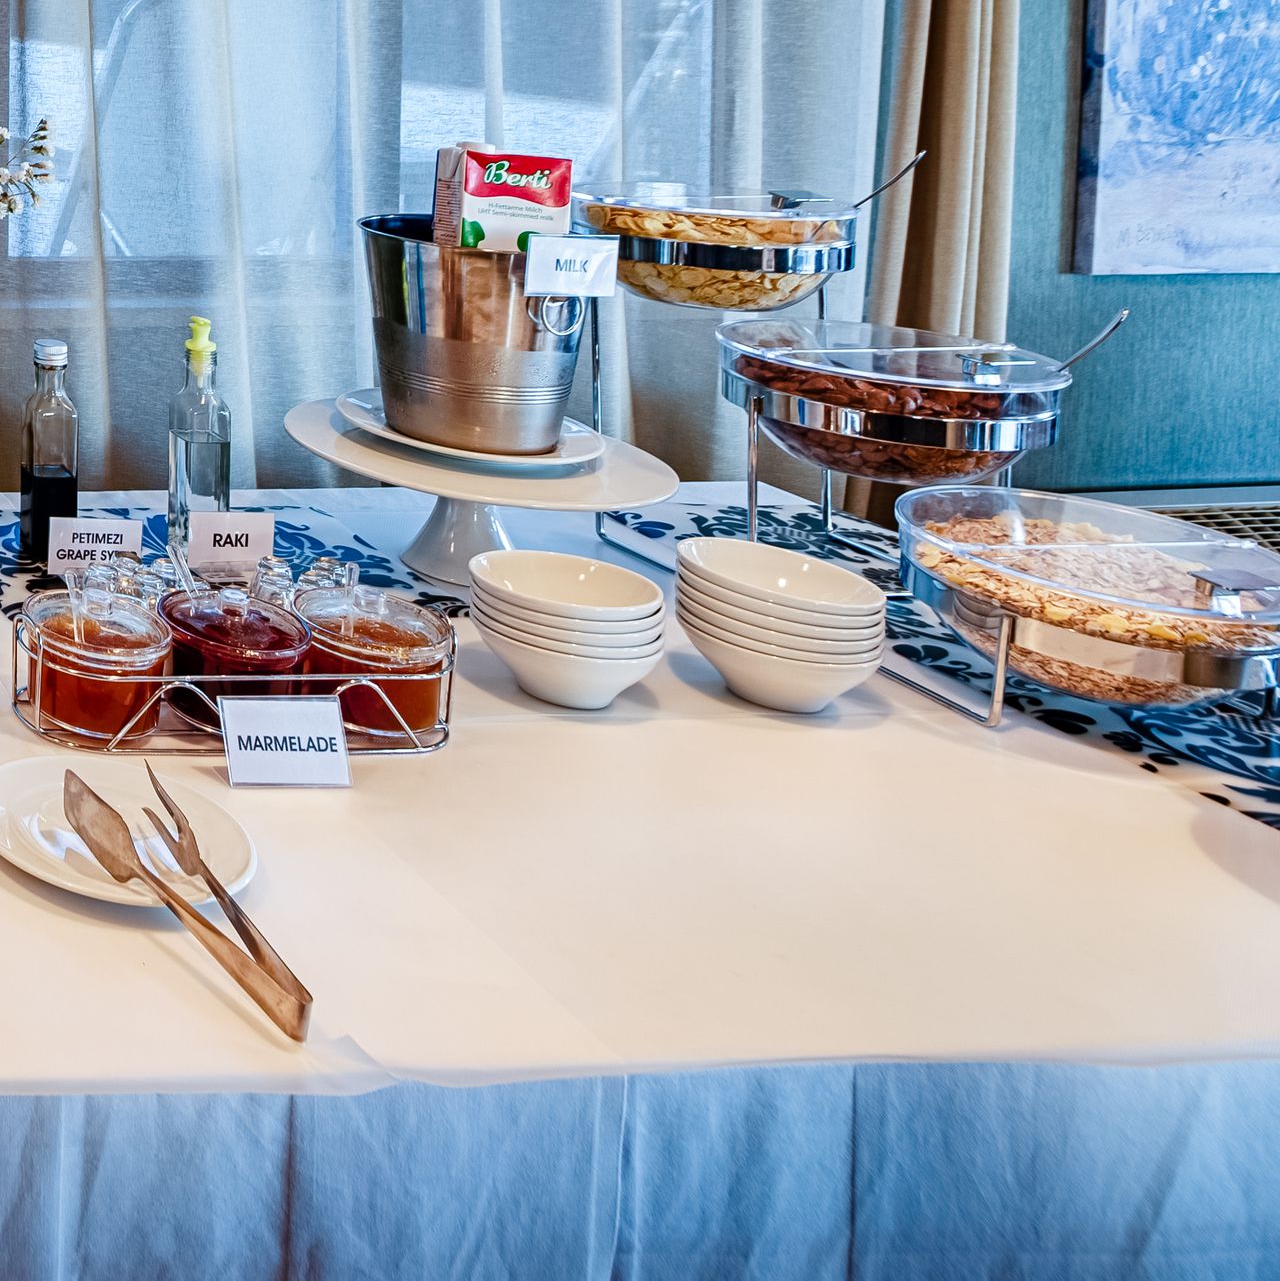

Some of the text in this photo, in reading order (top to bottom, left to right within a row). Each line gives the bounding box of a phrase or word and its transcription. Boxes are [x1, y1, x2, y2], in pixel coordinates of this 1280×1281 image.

[484, 160, 553, 189] Berti
[555, 258, 589, 273] MILK
[72, 532, 123, 545] PETIMEZI
[212, 532, 249, 548] RAKI
[56, 548, 97, 560] GRAPE
[237, 734, 338, 753] MARMELADE
